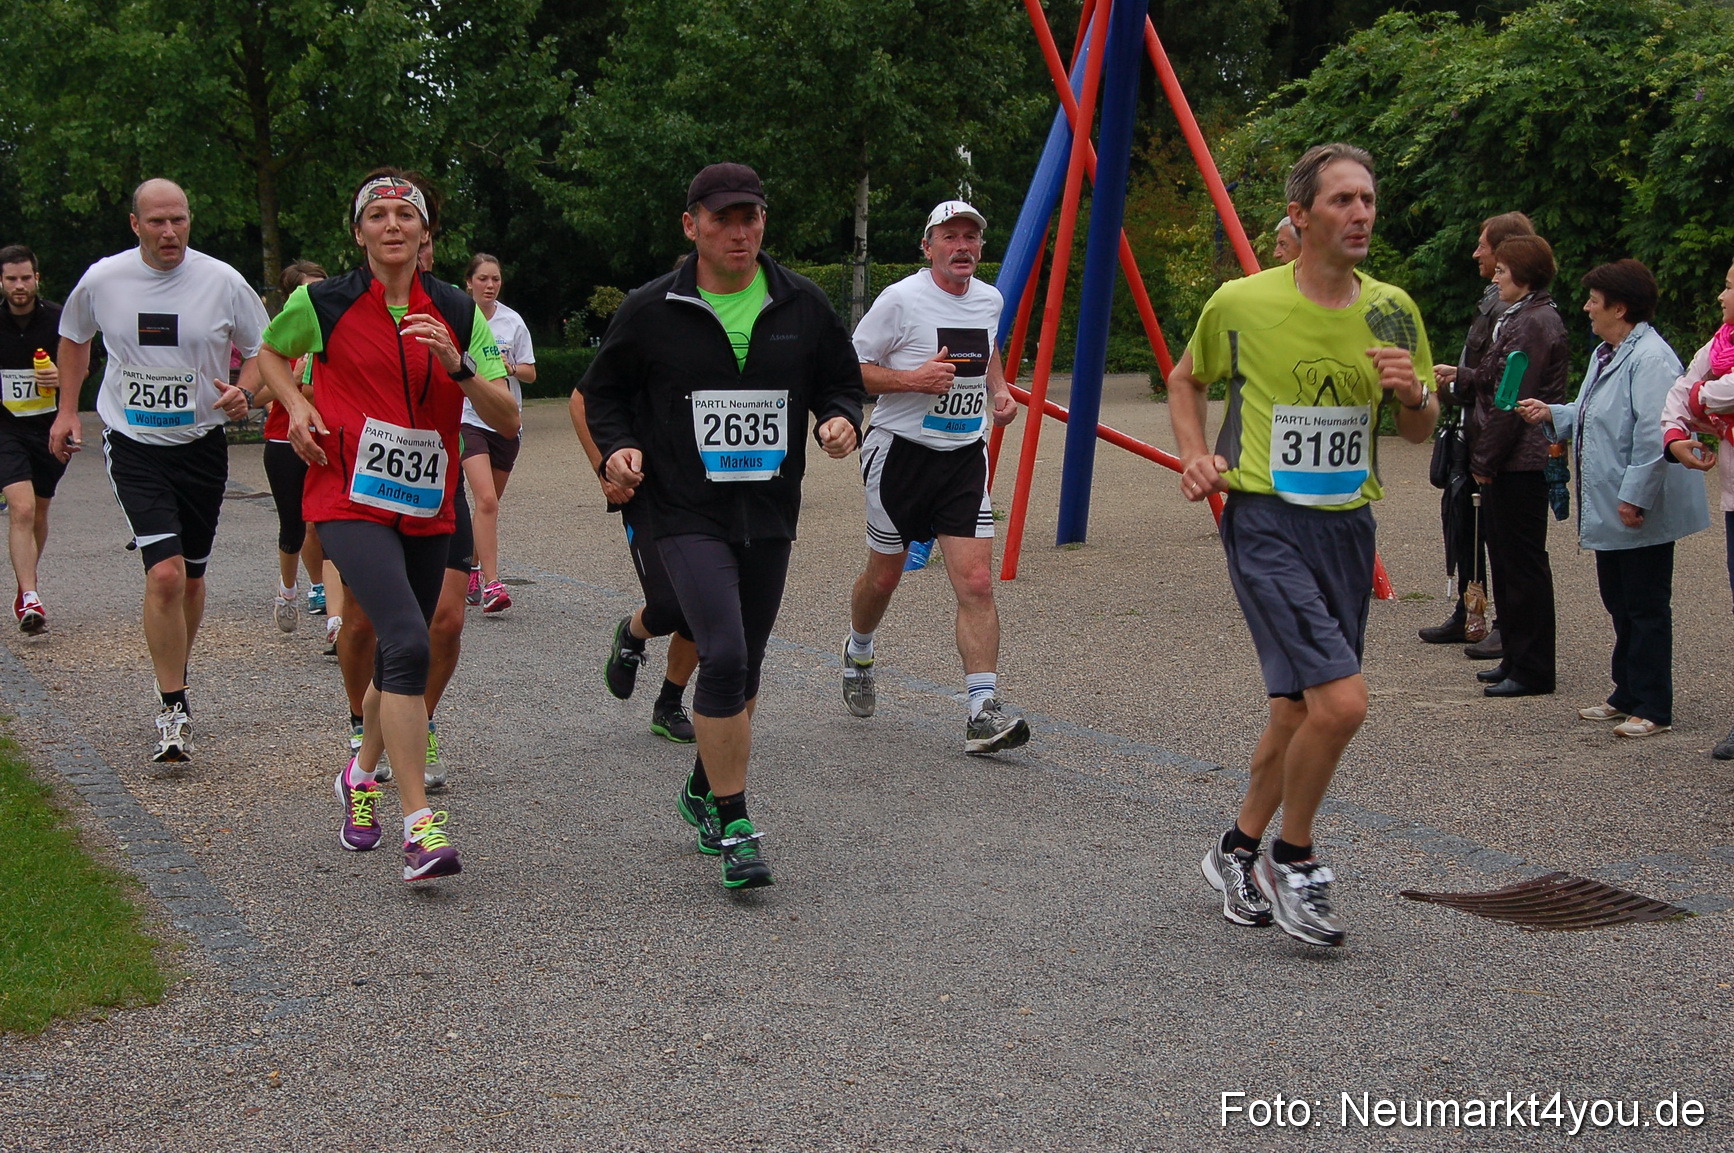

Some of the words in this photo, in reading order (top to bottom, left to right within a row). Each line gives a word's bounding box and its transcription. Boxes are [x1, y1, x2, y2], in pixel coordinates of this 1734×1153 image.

[122, 370, 144, 380] PARTL
[145, 373, 182, 382] Neumarkt
[128, 381, 188, 409] 2546
[695, 400, 727, 409] PARTL
[729, 400, 773, 409] Neumarkt
[933, 392, 984, 416] 3036
[135, 413, 180, 427] Wolfgang
[703, 413, 780, 446] 2635
[945, 421, 967, 431] Alois
[1274, 414, 1311, 426] PARTL
[1313, 416, 1358, 426] Neumarkt
[364, 426, 394, 442] PARTL
[395, 435, 436, 448] Neumarkt
[1281, 430, 1363, 467] 3186
[365, 442, 440, 484] 2634
[720, 455, 763, 468] Markus
[376, 483, 420, 504] Andrea
